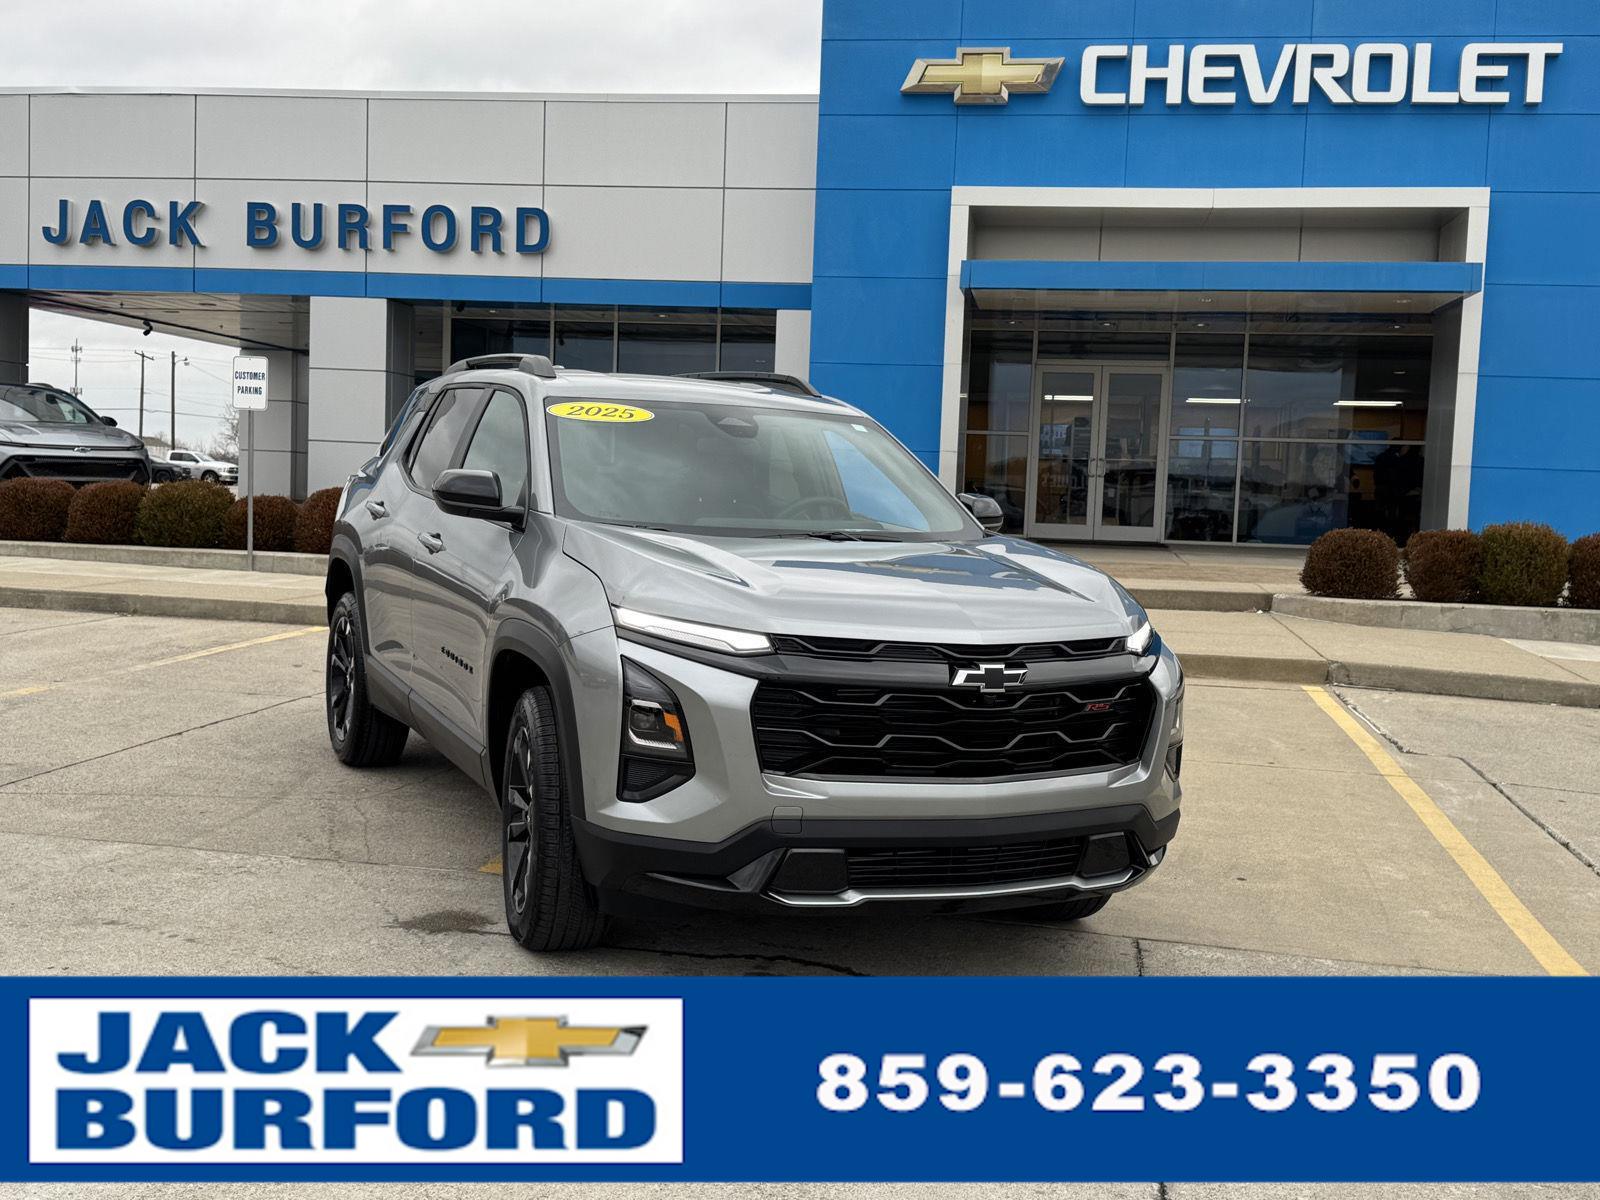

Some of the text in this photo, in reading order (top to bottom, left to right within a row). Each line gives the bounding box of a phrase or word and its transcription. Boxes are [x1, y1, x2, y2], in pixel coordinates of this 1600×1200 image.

[1080, 42, 1563, 105] CHEVROLET
[42, 199, 552, 254] JACK BURFORD
[235, 371, 266, 380] CUSTOMER
[237, 385, 263, 395] PARKING
[566, 405, 636, 419] 2025
